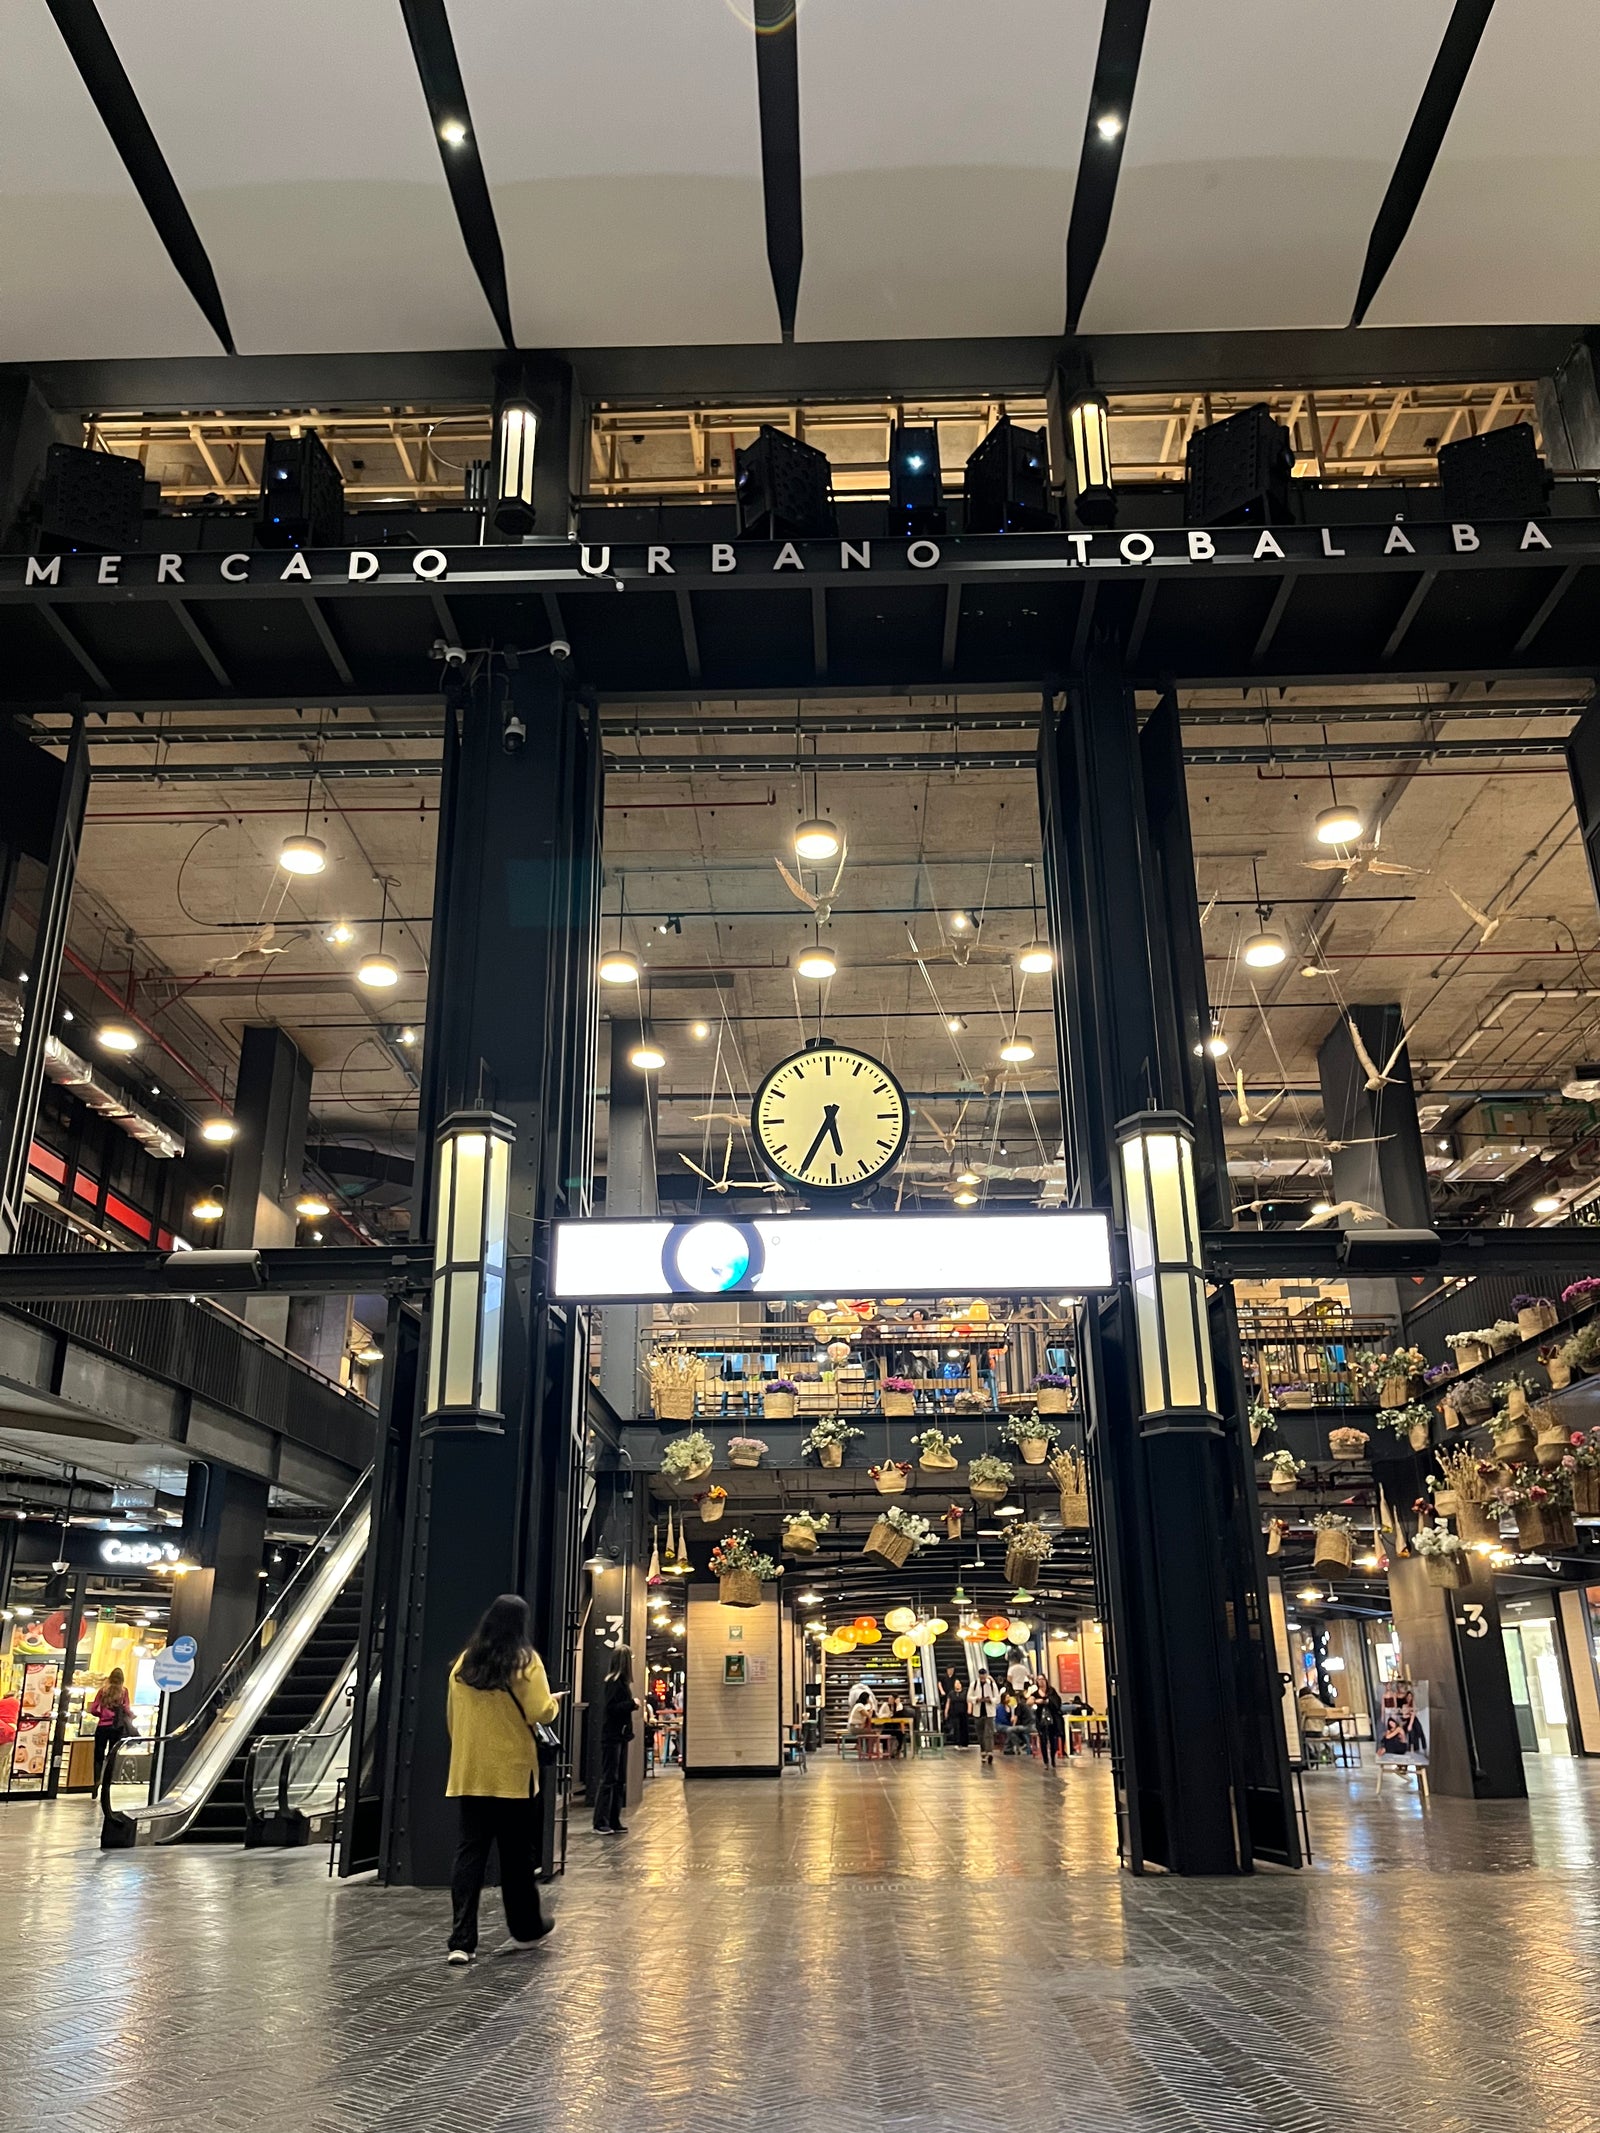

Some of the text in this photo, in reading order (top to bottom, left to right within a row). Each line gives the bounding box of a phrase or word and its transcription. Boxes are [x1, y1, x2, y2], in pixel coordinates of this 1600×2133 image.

[25, 521, 1552, 586] MERCADO URBANO TOBALABA
[594, 1615, 624, 1649] -3
[1455, 1604, 1489, 1638] -3
